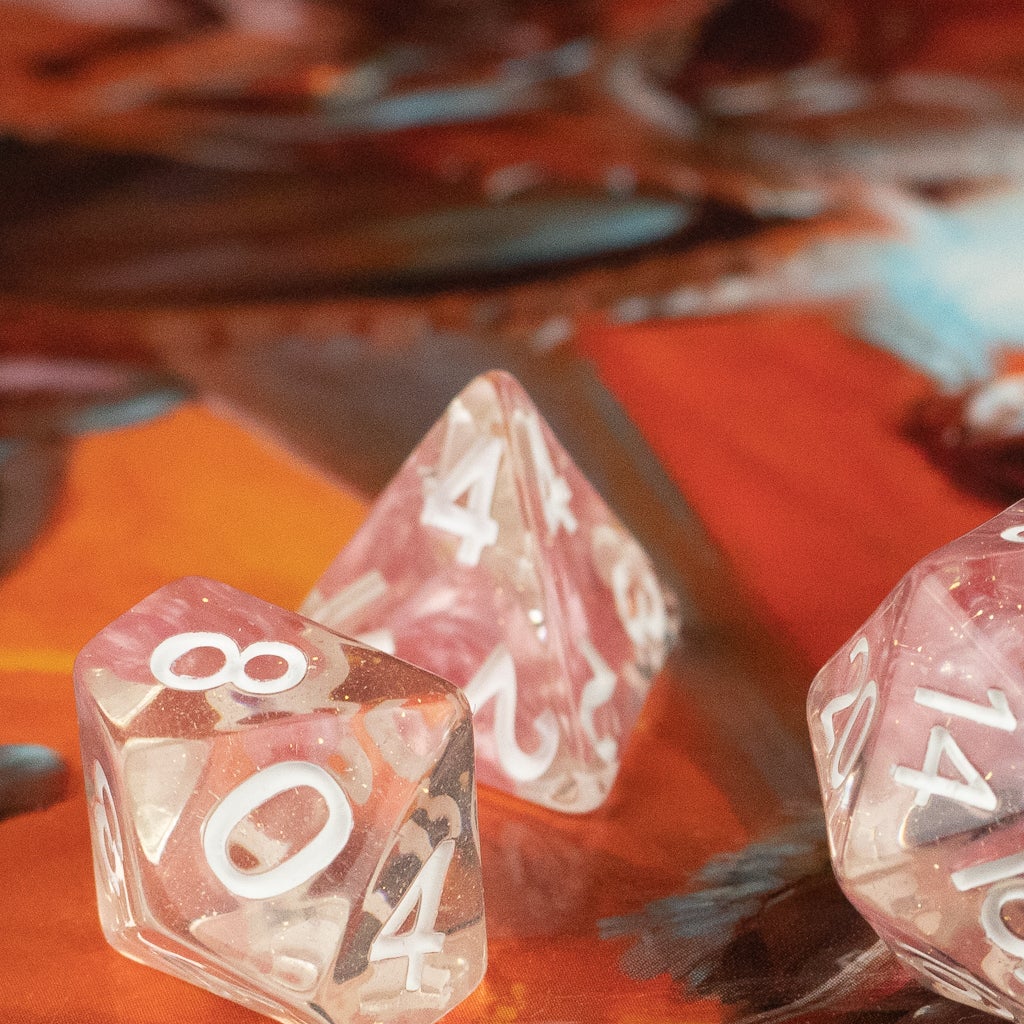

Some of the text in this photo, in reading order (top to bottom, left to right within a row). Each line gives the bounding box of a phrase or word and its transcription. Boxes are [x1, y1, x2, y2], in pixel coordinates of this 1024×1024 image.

[420, 438, 506, 566] 4
[149, 631, 309, 696] 8
[890, 687, 1017, 811] 14
[203, 761, 355, 900] 0
[371, 839, 456, 992] 4
